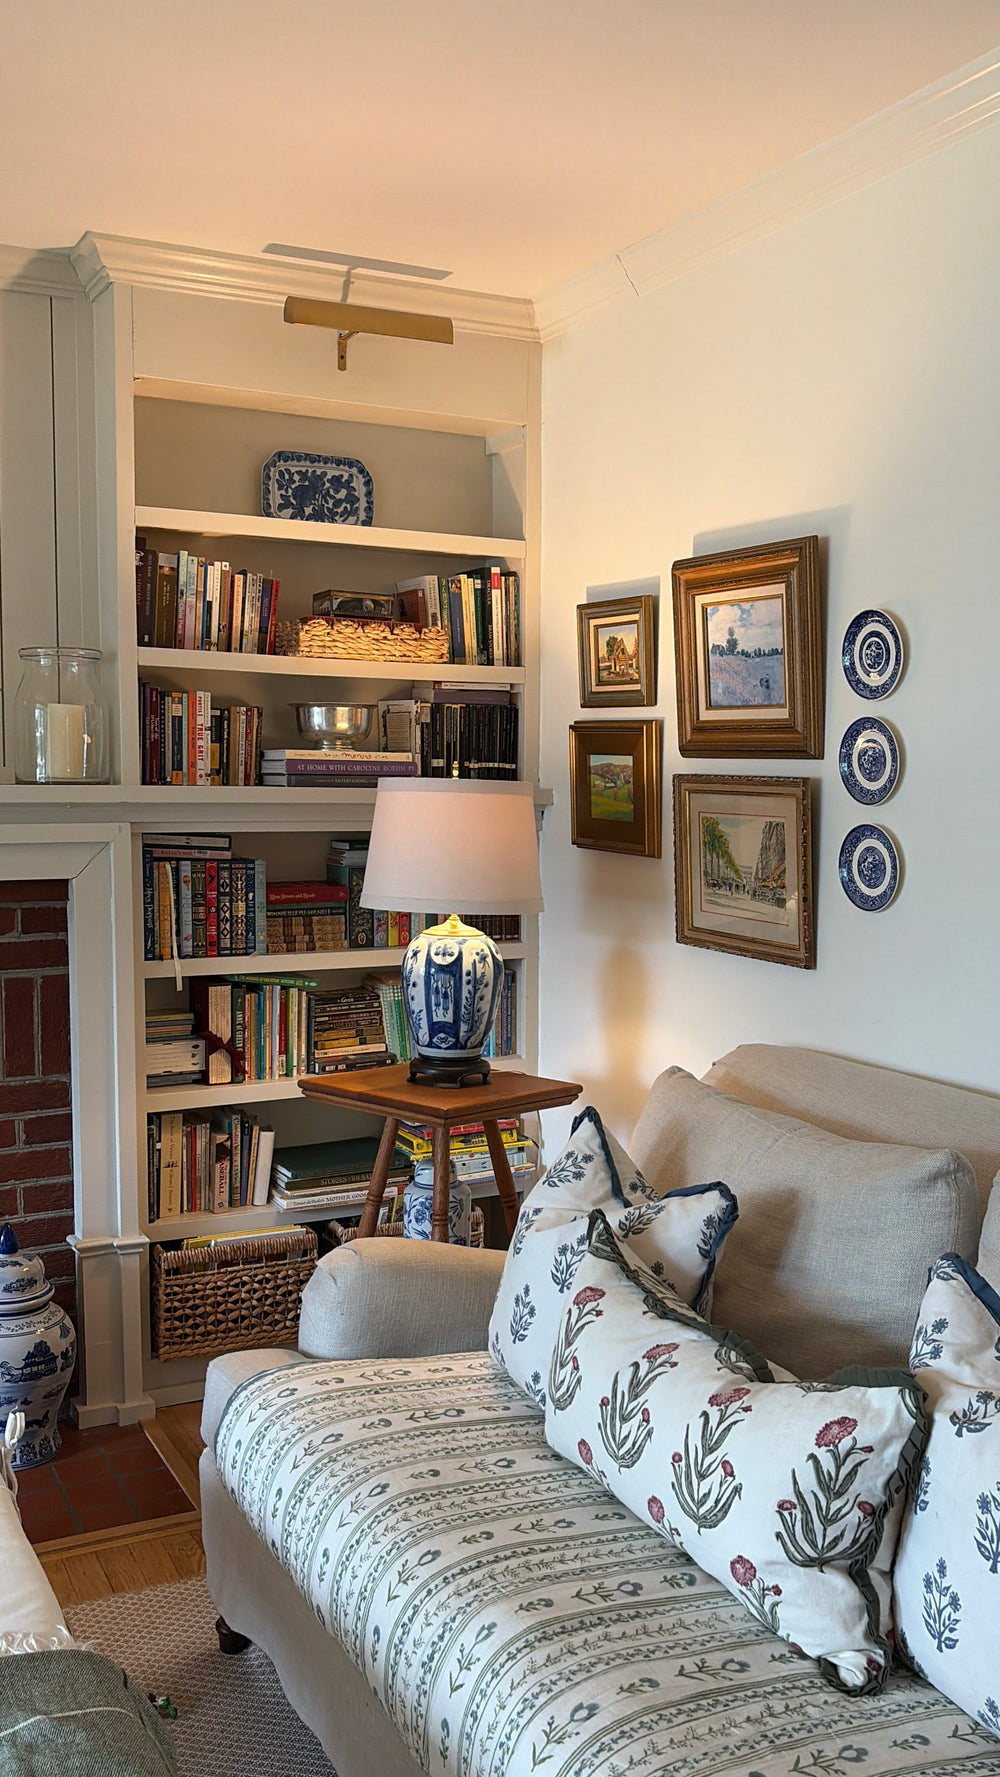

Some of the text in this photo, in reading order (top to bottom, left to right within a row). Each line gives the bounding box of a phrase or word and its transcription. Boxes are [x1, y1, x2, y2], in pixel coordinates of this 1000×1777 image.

[296, 763, 305, 771] AT
[347, 764, 381, 772] CAROLYNE
[320, 1177, 348, 1186] STORIES
[326, 1195, 352, 1203] MOTHER
